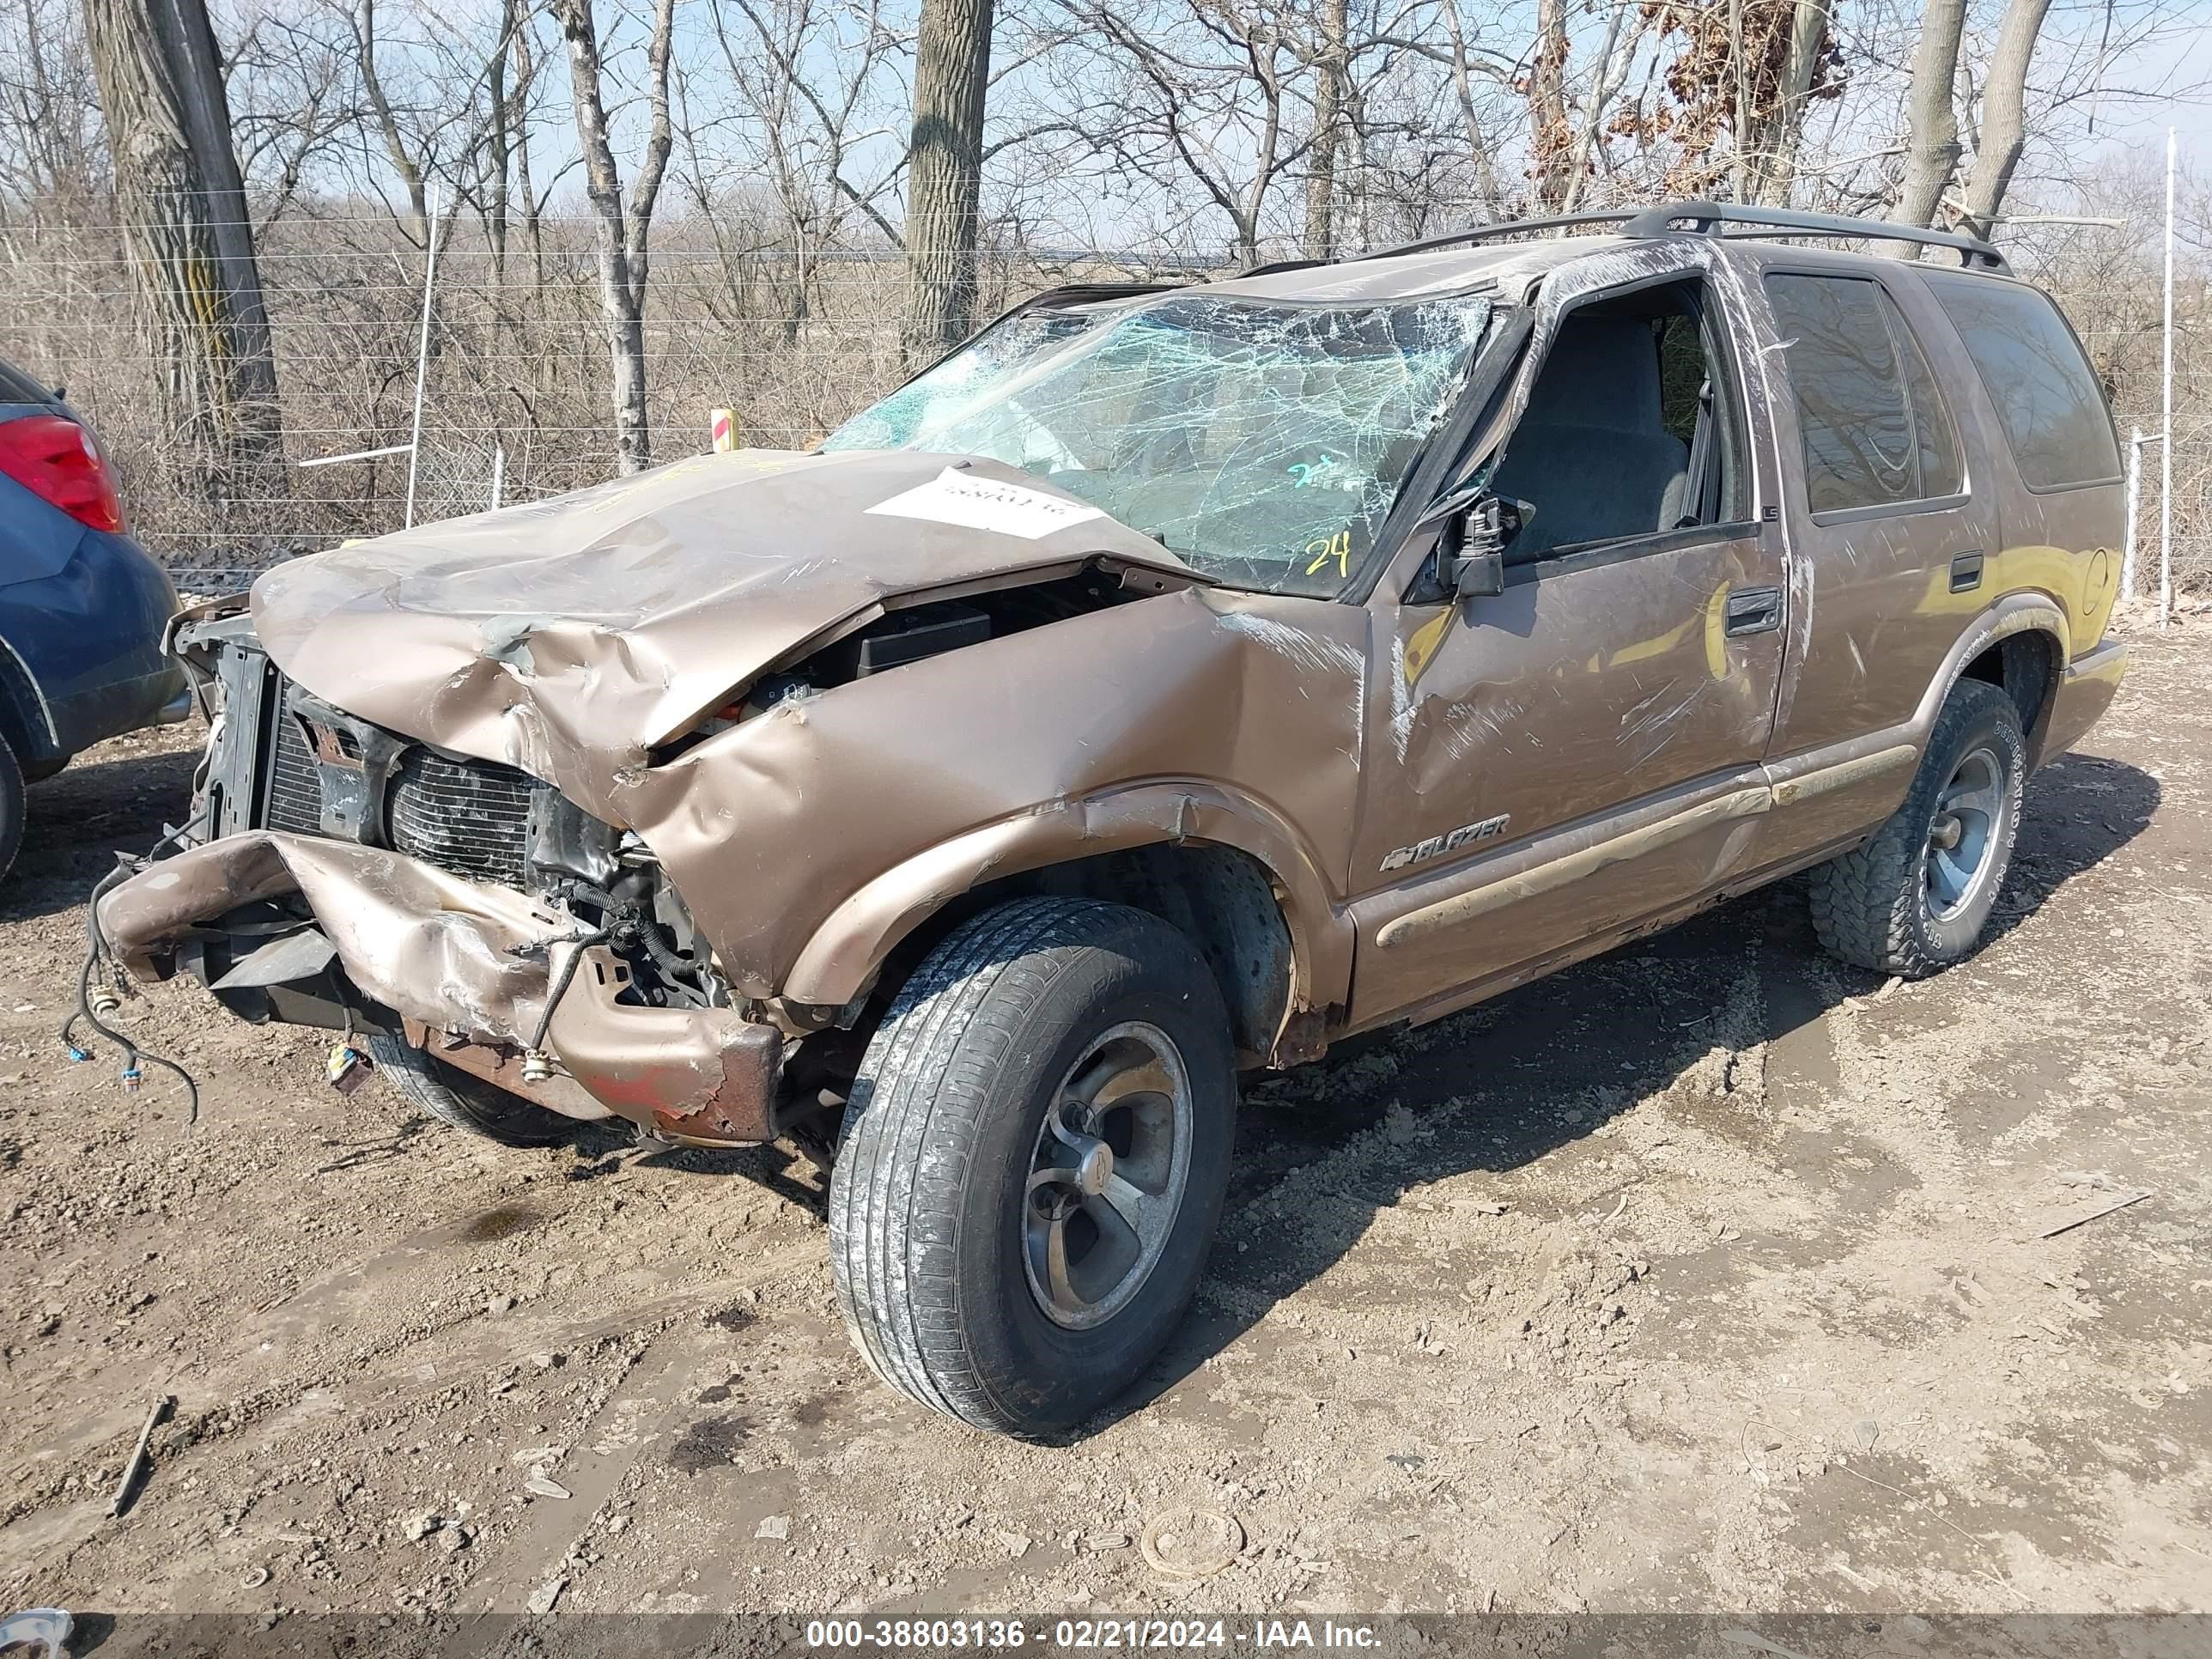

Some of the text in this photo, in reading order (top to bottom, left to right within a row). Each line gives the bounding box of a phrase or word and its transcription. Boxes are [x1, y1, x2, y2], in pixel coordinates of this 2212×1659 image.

[1763, 507, 1778, 520] LS
[1304, 530, 1351, 578] 24
[1413, 812, 1511, 864] BLAZER
